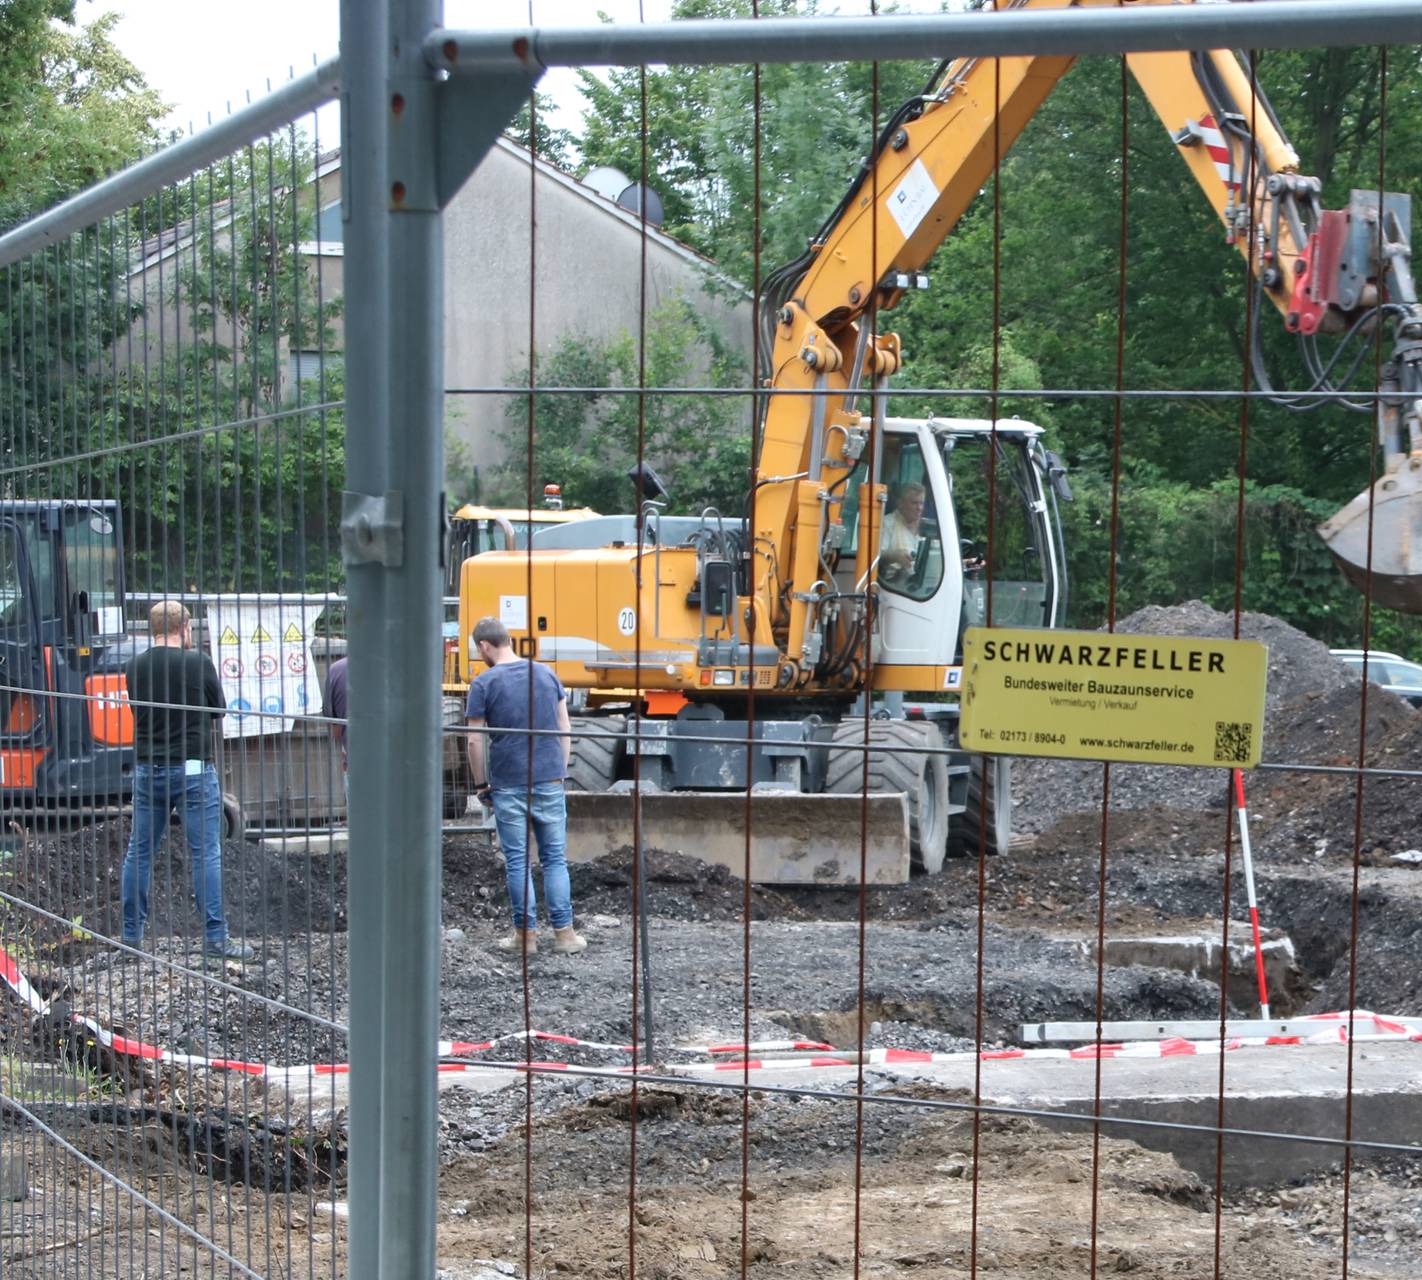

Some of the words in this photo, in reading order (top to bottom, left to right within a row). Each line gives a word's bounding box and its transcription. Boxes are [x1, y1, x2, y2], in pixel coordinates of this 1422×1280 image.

[621, 611, 634, 630] 20
[984, 641, 1225, 673] SCHWARZFELLER
[1004, 675, 1084, 693] Bundesweiter
[1087, 680, 1195, 699] Bauzaunservice
[1049, 696, 1097, 711] Vermietung
[1104, 700, 1138, 710] Verkauf
[979, 728, 995, 740] Tel:
[1000, 730, 1027, 742] 02173
[1034, 733, 1066, 745] 8904-0
[1079, 735, 1195, 753] www.schwarzfeller.de
